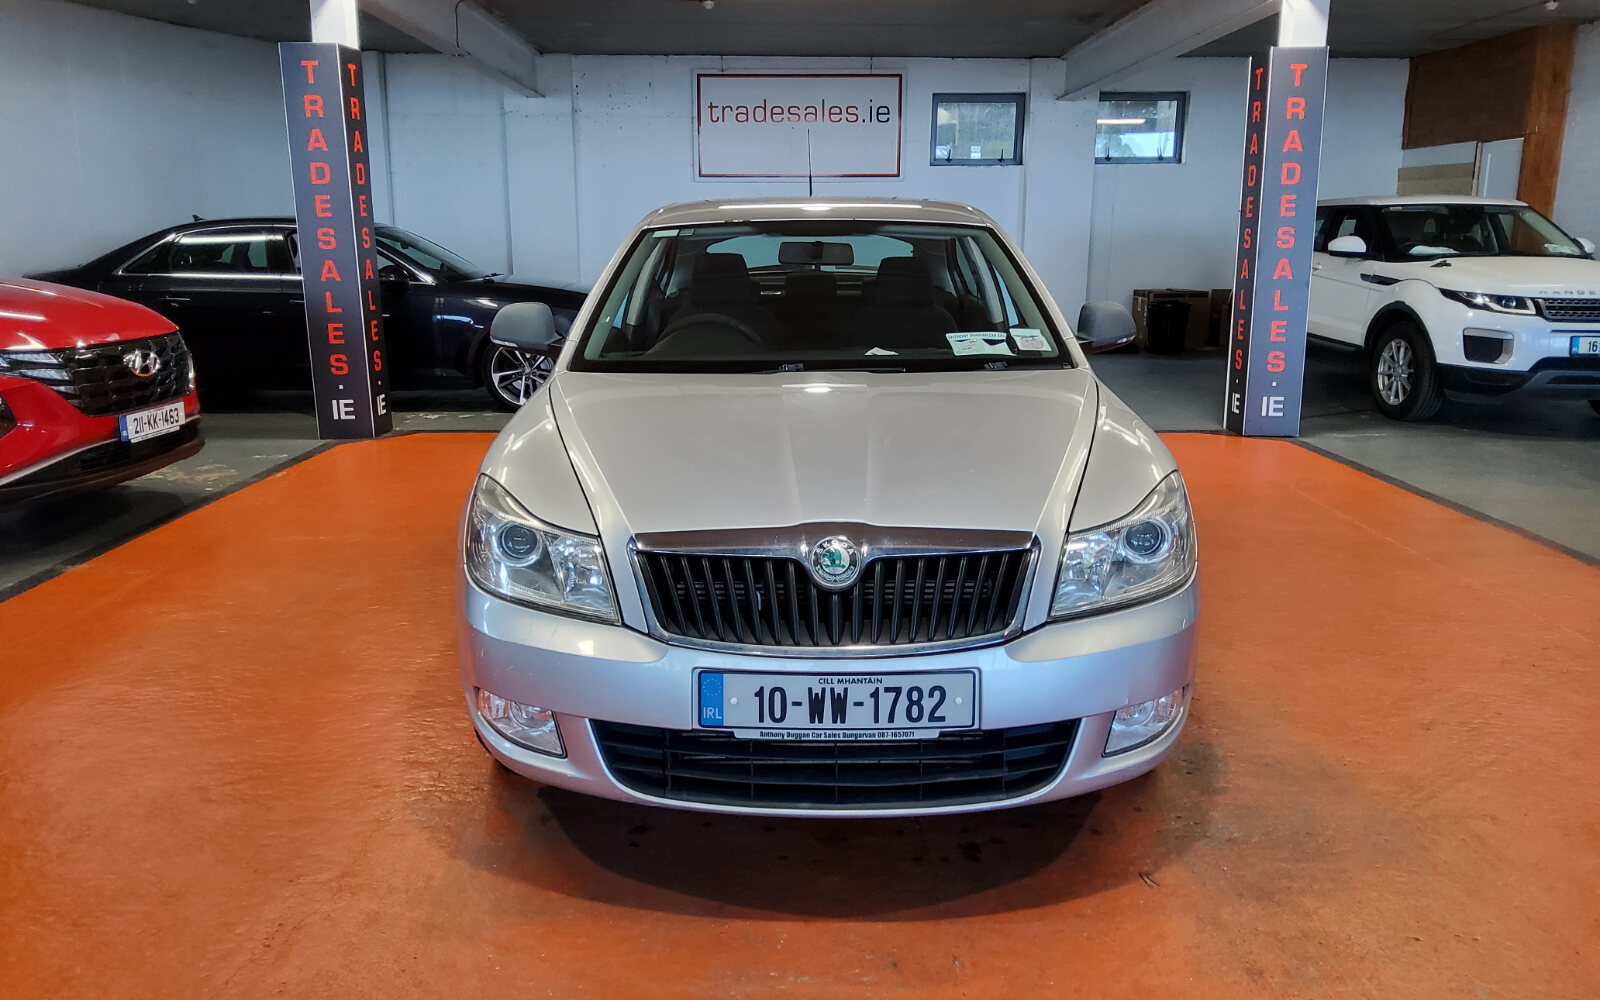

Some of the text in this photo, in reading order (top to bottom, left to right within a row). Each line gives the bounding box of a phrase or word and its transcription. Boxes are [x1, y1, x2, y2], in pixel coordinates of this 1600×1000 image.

[707, 98, 891, 124] tradesales.ie
[133, 408, 179, 434] 211-KK-1463
[703, 707, 722, 719] IRL
[754, 685, 947, 724] 10-WW-1782
[760, 730, 785, 739] Anthony
[786, 731, 810, 740] Duggan
[811, 731, 823, 739] Car
[824, 731, 841, 739] Sales
[842, 731, 876, 740] Dungarvan
